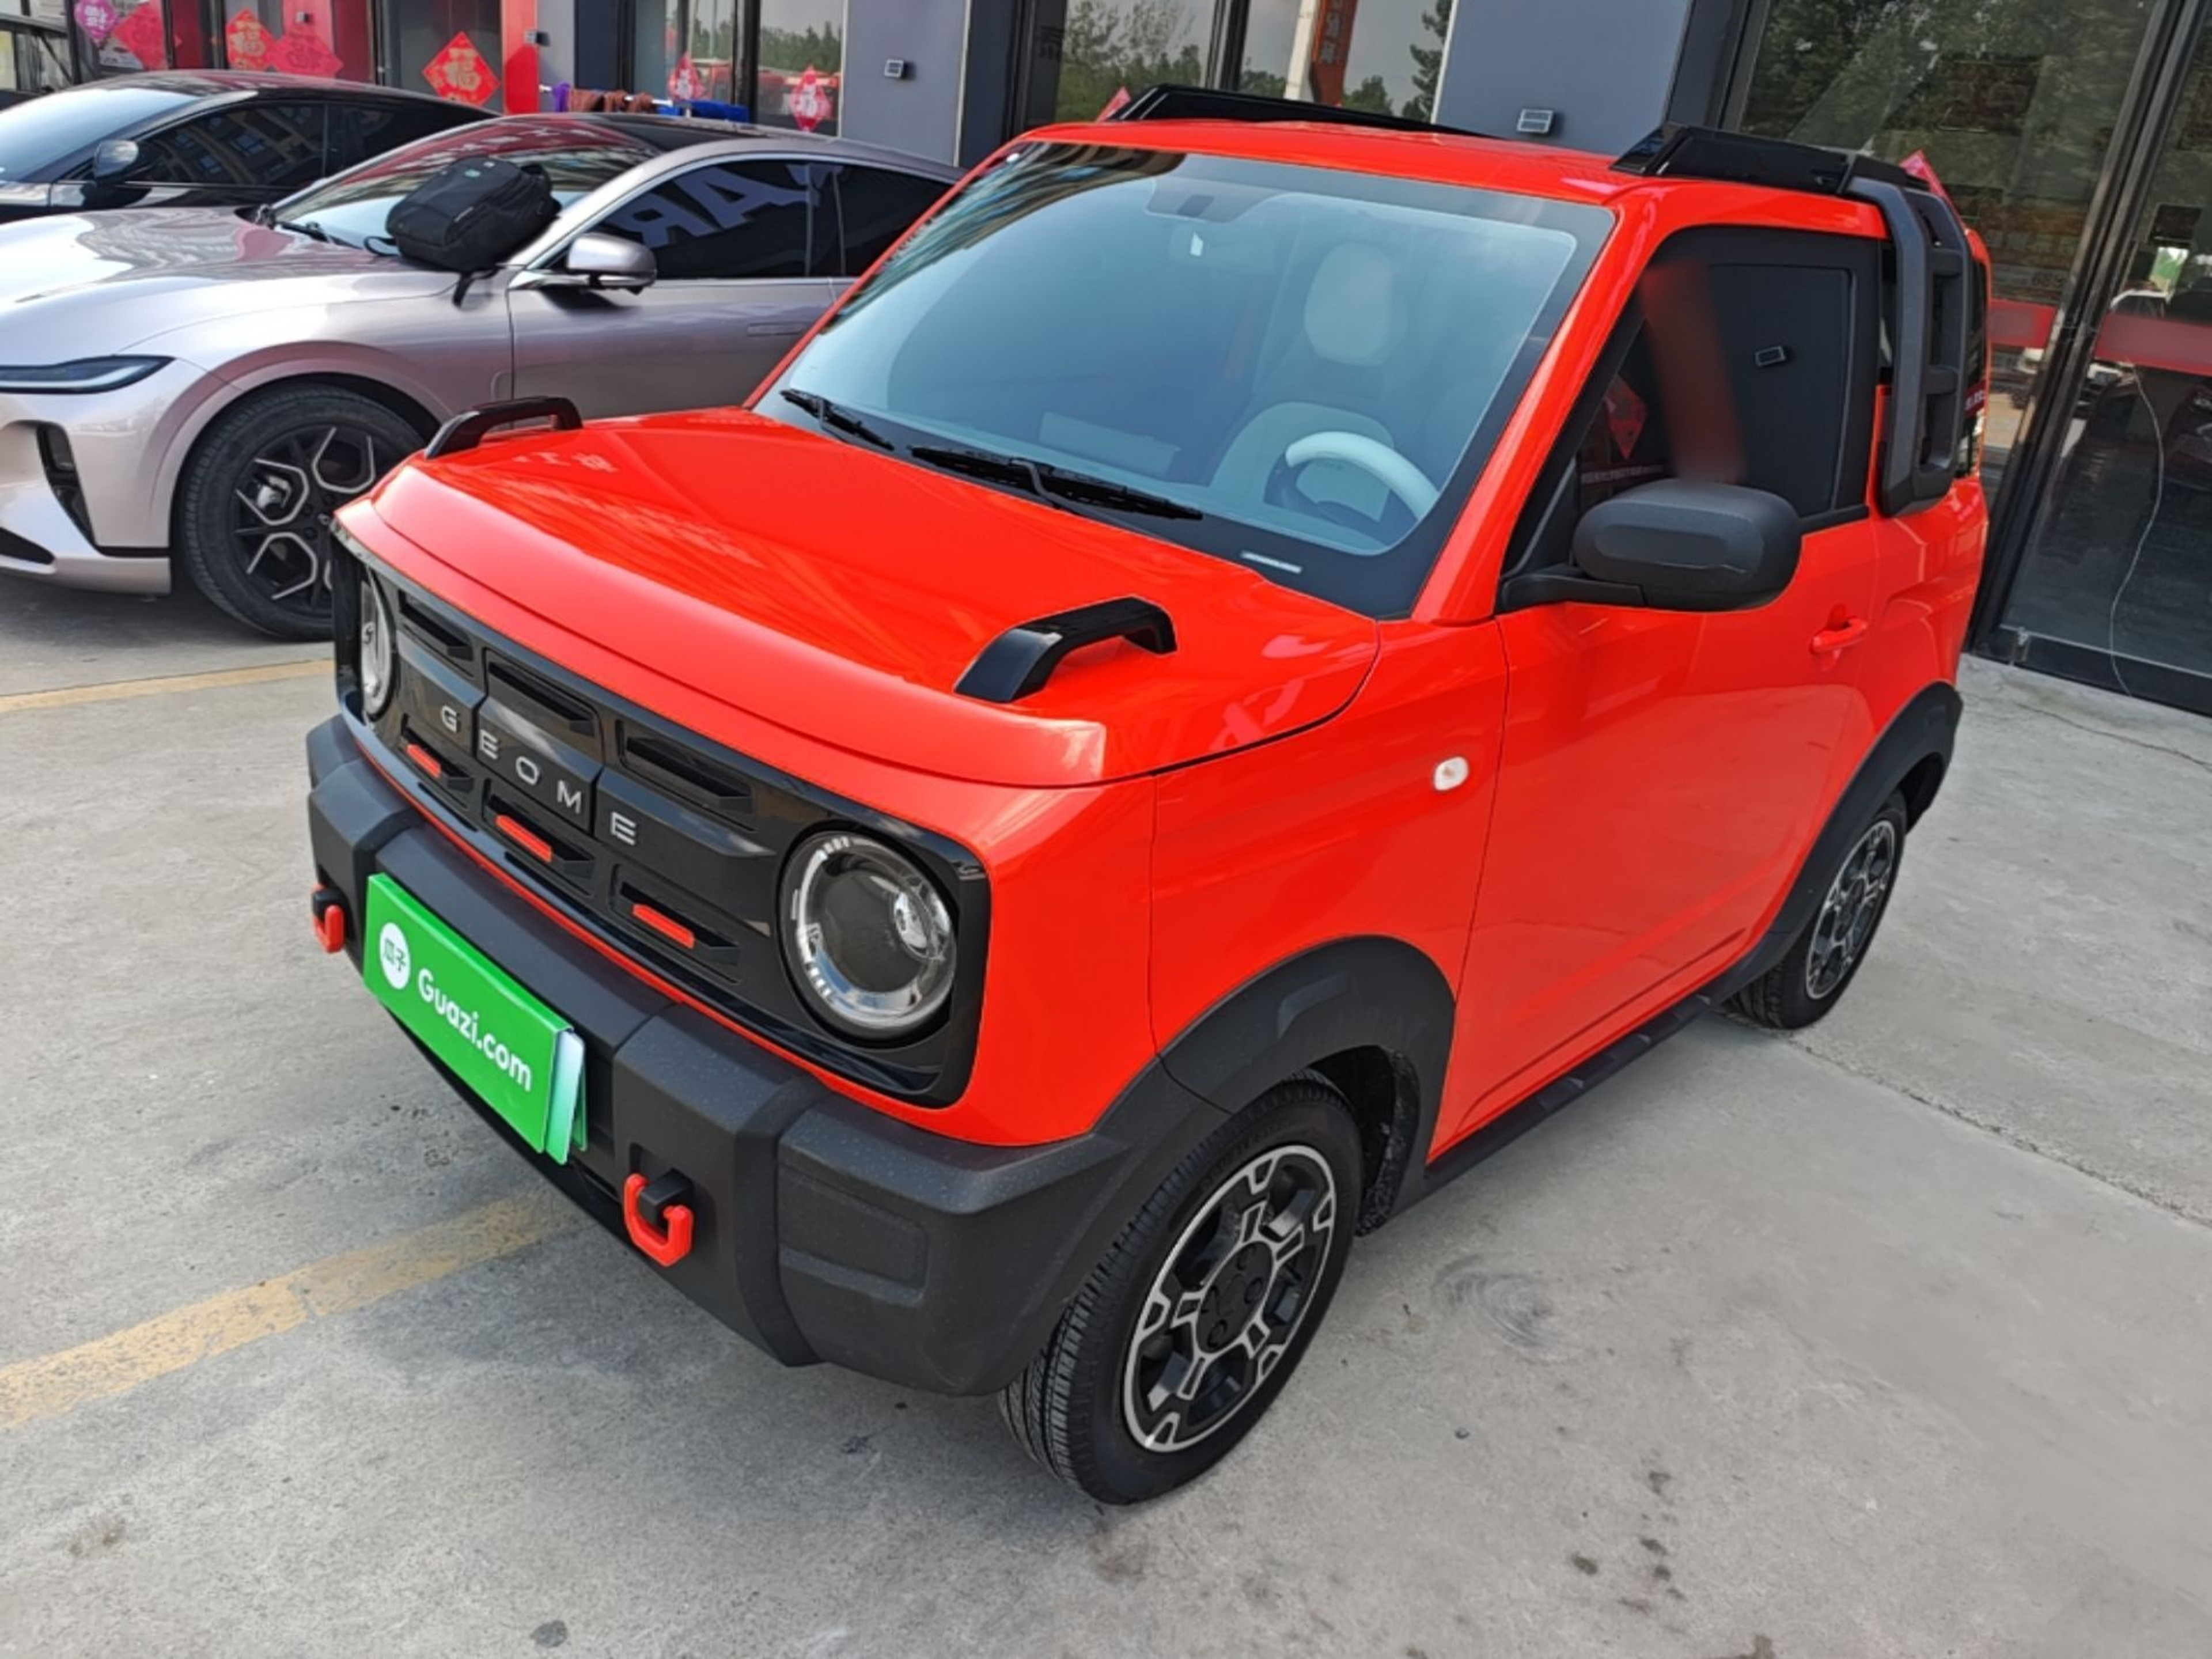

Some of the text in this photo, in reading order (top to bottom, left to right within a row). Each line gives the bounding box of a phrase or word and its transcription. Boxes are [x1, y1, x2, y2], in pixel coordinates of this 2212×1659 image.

[442, 47, 481, 92] 福
[440, 704, 637, 846] GEOME
[418, 967, 532, 1092] Guazi.com
